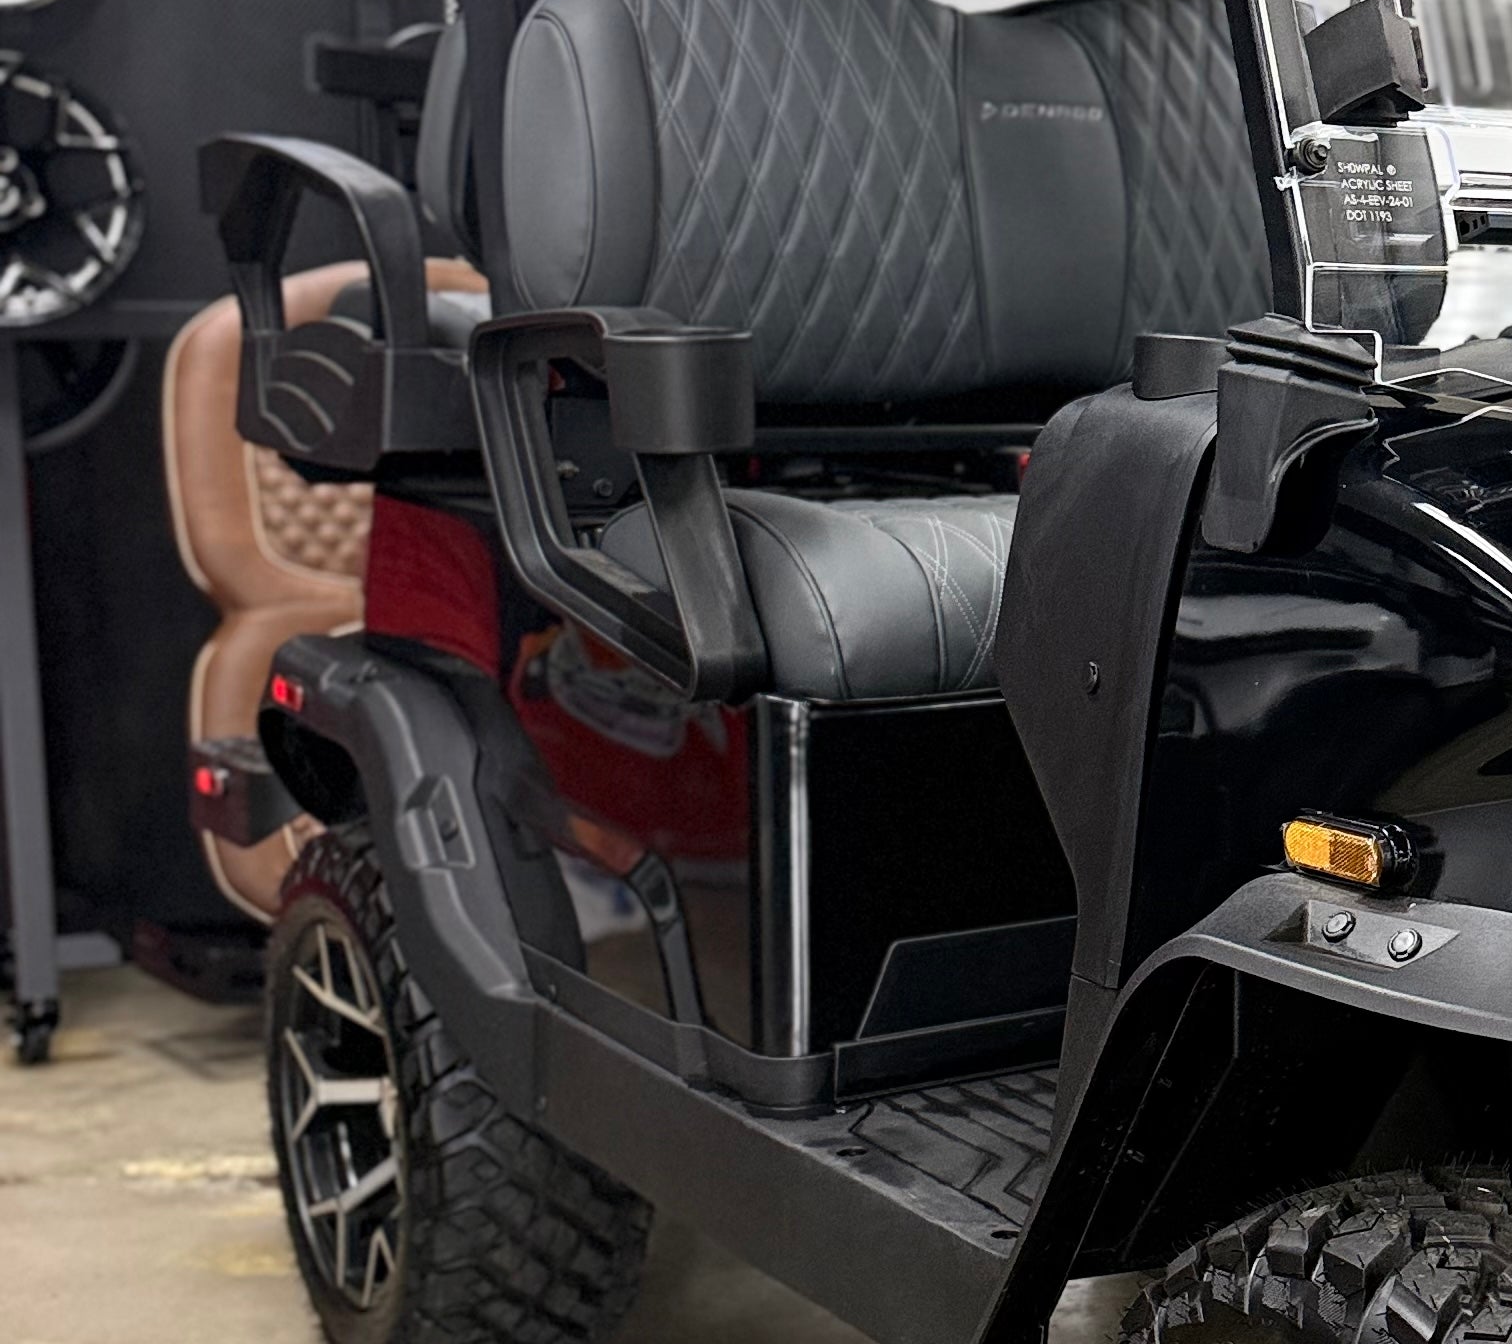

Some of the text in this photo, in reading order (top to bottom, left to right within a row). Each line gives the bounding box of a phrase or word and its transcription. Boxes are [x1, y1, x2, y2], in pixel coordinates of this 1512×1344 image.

[1340, 178, 1413, 192] ACRYLIC SHEET
[1345, 209, 1368, 222] DOT
